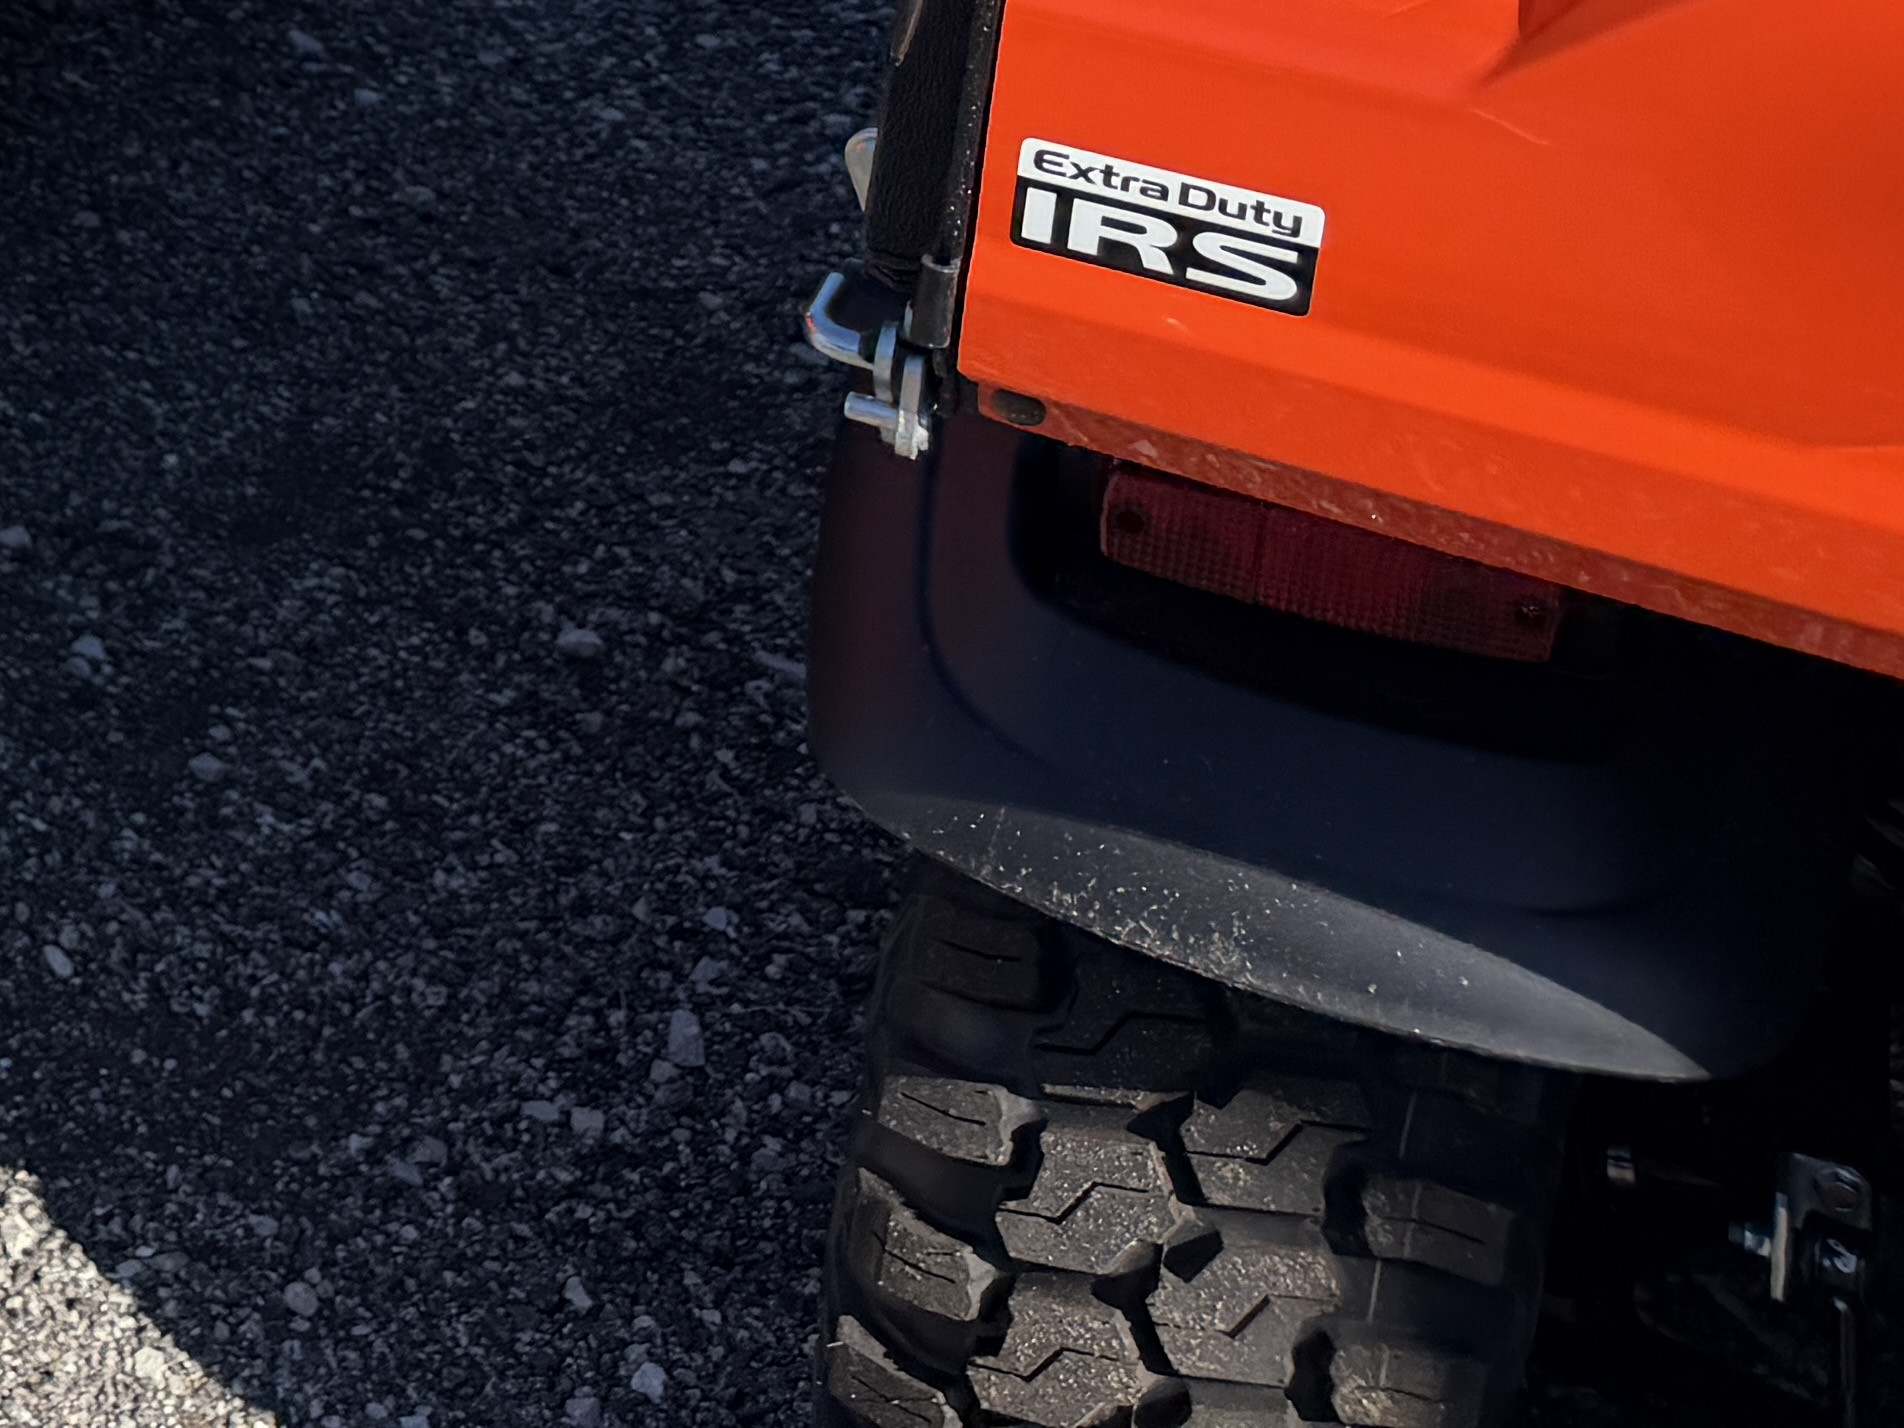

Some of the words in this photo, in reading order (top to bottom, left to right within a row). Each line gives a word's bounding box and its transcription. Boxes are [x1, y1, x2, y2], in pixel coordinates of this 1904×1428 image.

[1033, 147, 1172, 202] Extra
[1178, 181, 1304, 239] Duty
[1021, 188, 1299, 304] IRS
